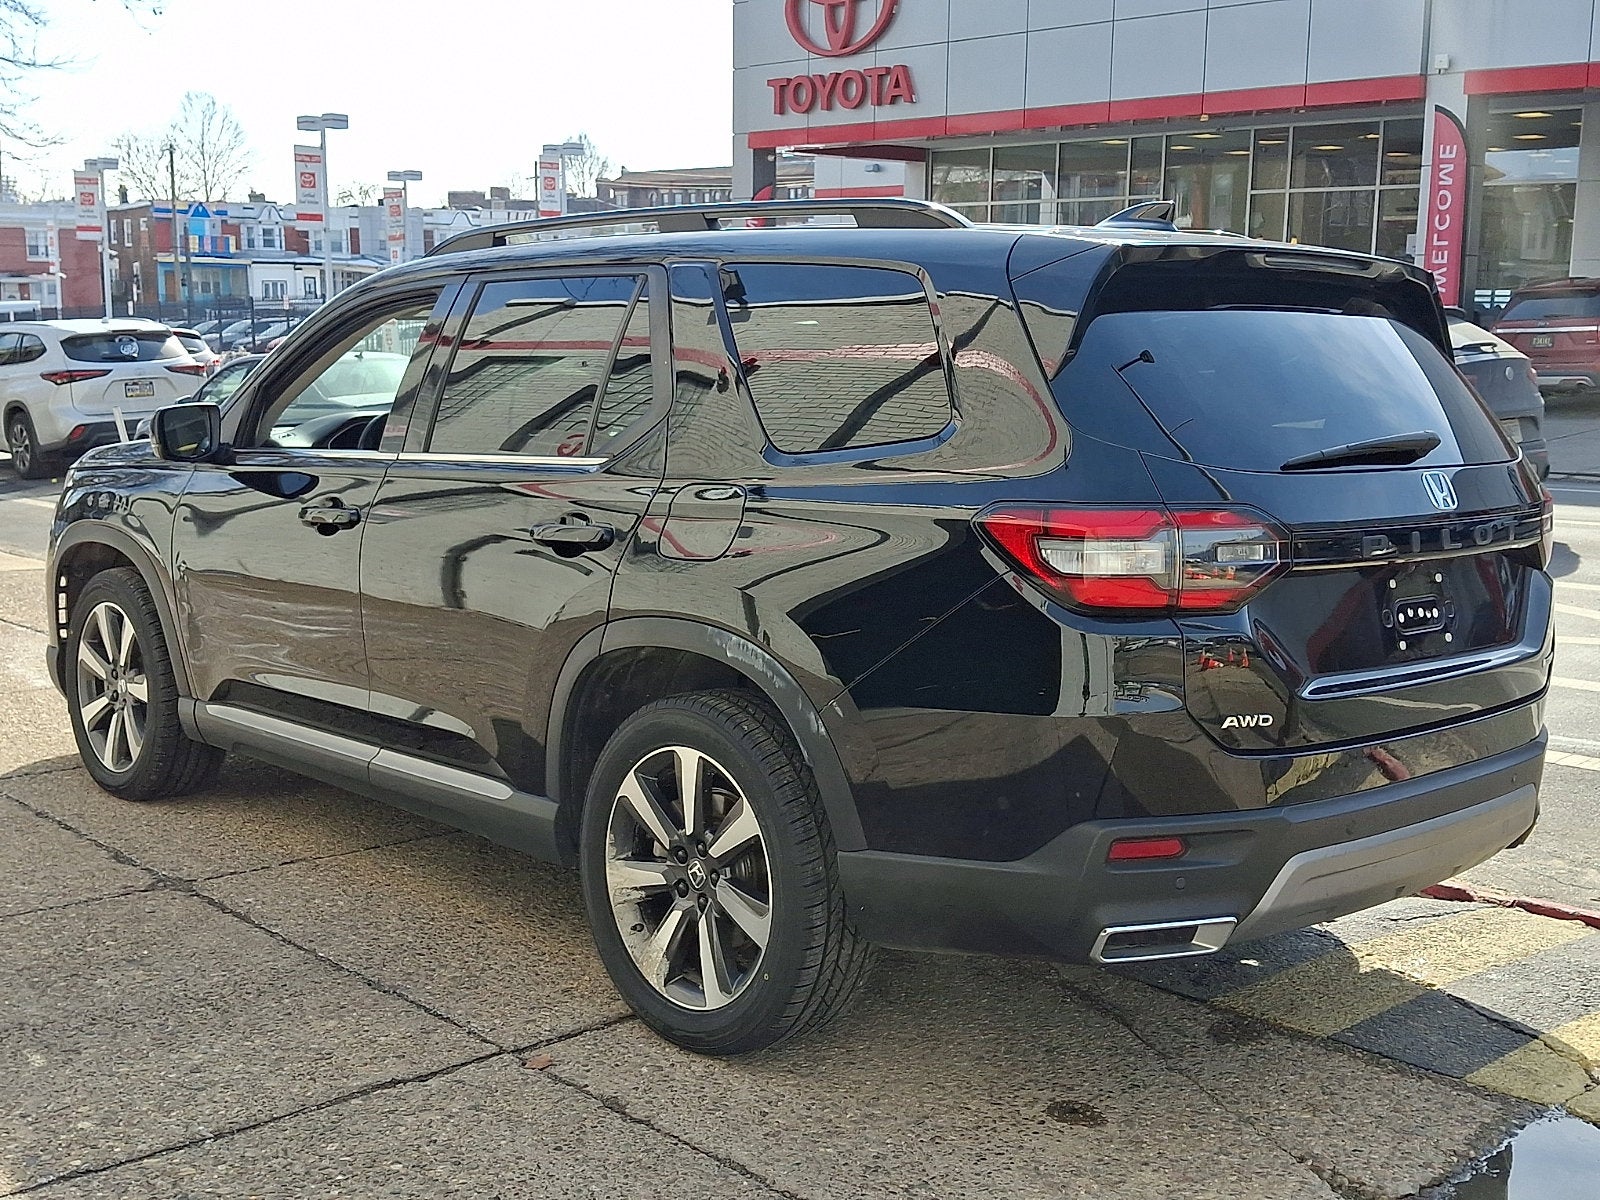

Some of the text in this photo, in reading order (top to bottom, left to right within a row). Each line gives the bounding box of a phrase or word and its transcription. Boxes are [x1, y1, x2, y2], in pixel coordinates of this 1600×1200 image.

[767, 64, 917, 115] TOYOTA
[1431, 143, 1458, 293] WELCOME
[1362, 519, 1519, 560] PILOT
[1220, 713, 1274, 731] AWD
